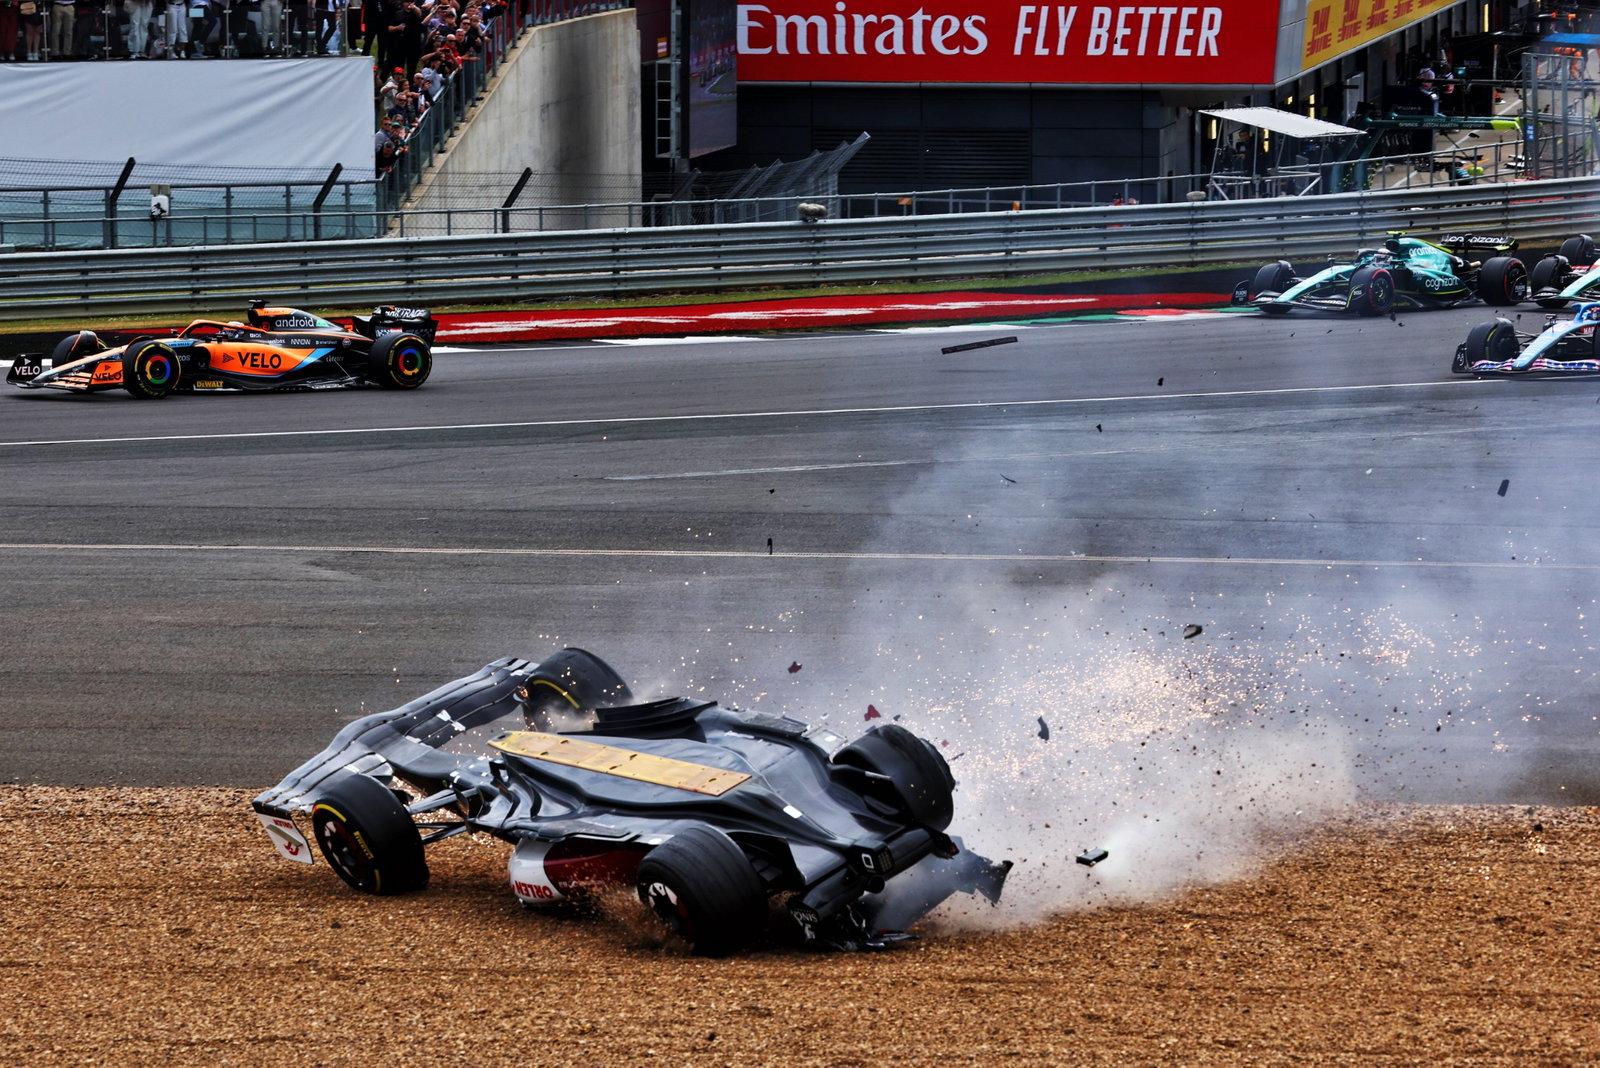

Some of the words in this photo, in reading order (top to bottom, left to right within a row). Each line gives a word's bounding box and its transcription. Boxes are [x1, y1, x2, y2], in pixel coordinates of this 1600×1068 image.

[736, 2, 987, 54] Emirates
[1014, 6, 1077, 55] FLY
[1087, 7, 1222, 56] BETTER
[275, 316, 315, 328] android
[238, 351, 282, 369] VELO
[15, 365, 41, 376] VELO
[95, 370, 123, 381] VELO
[515, 880, 555, 899] ORLEN
